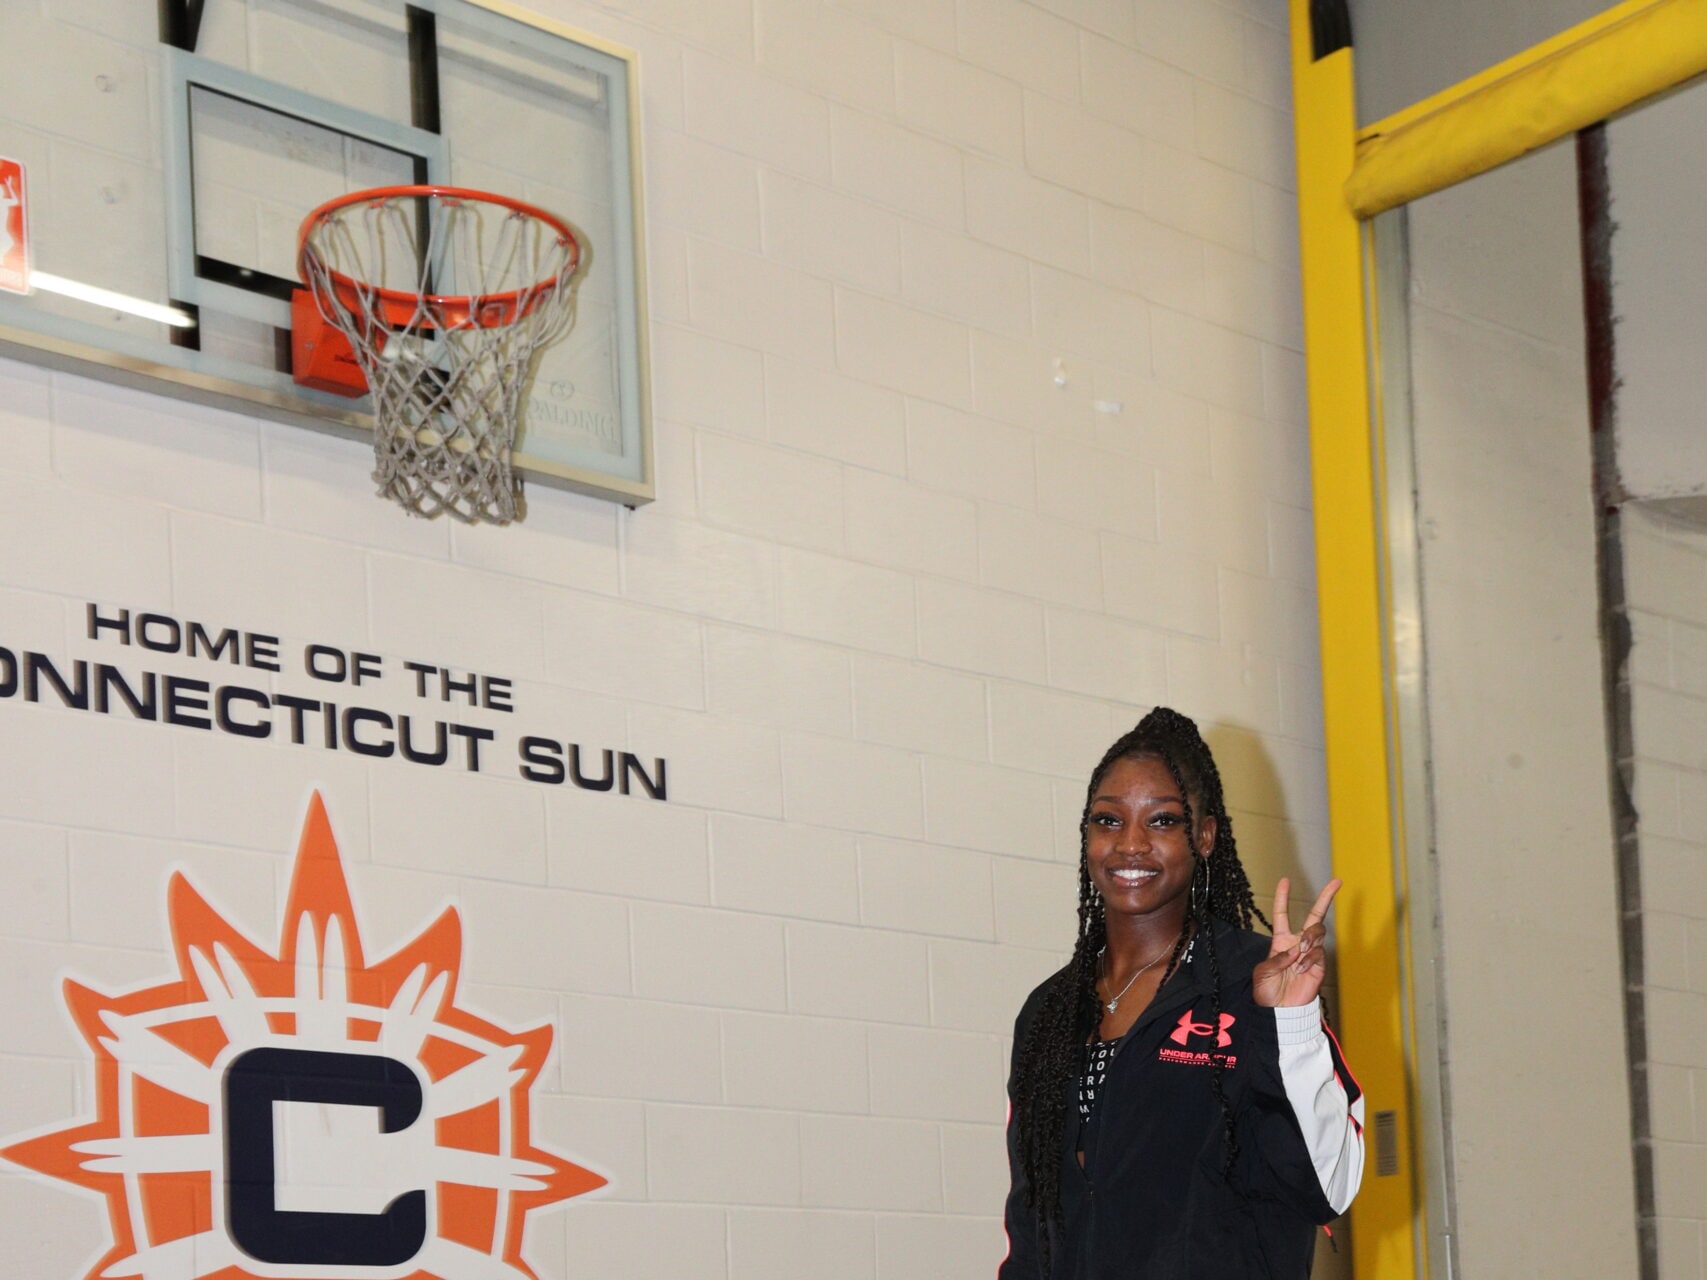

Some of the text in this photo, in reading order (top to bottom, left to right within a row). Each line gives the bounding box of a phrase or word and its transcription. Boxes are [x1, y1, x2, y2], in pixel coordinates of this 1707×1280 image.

[86, 602, 514, 713] HOME OF THE
[518, 735, 667, 801] SUN
[1159, 1048, 1194, 1060] UNDER
[1194, 1053, 1237, 1063] ARUR
[222, 1046, 427, 1266] C
